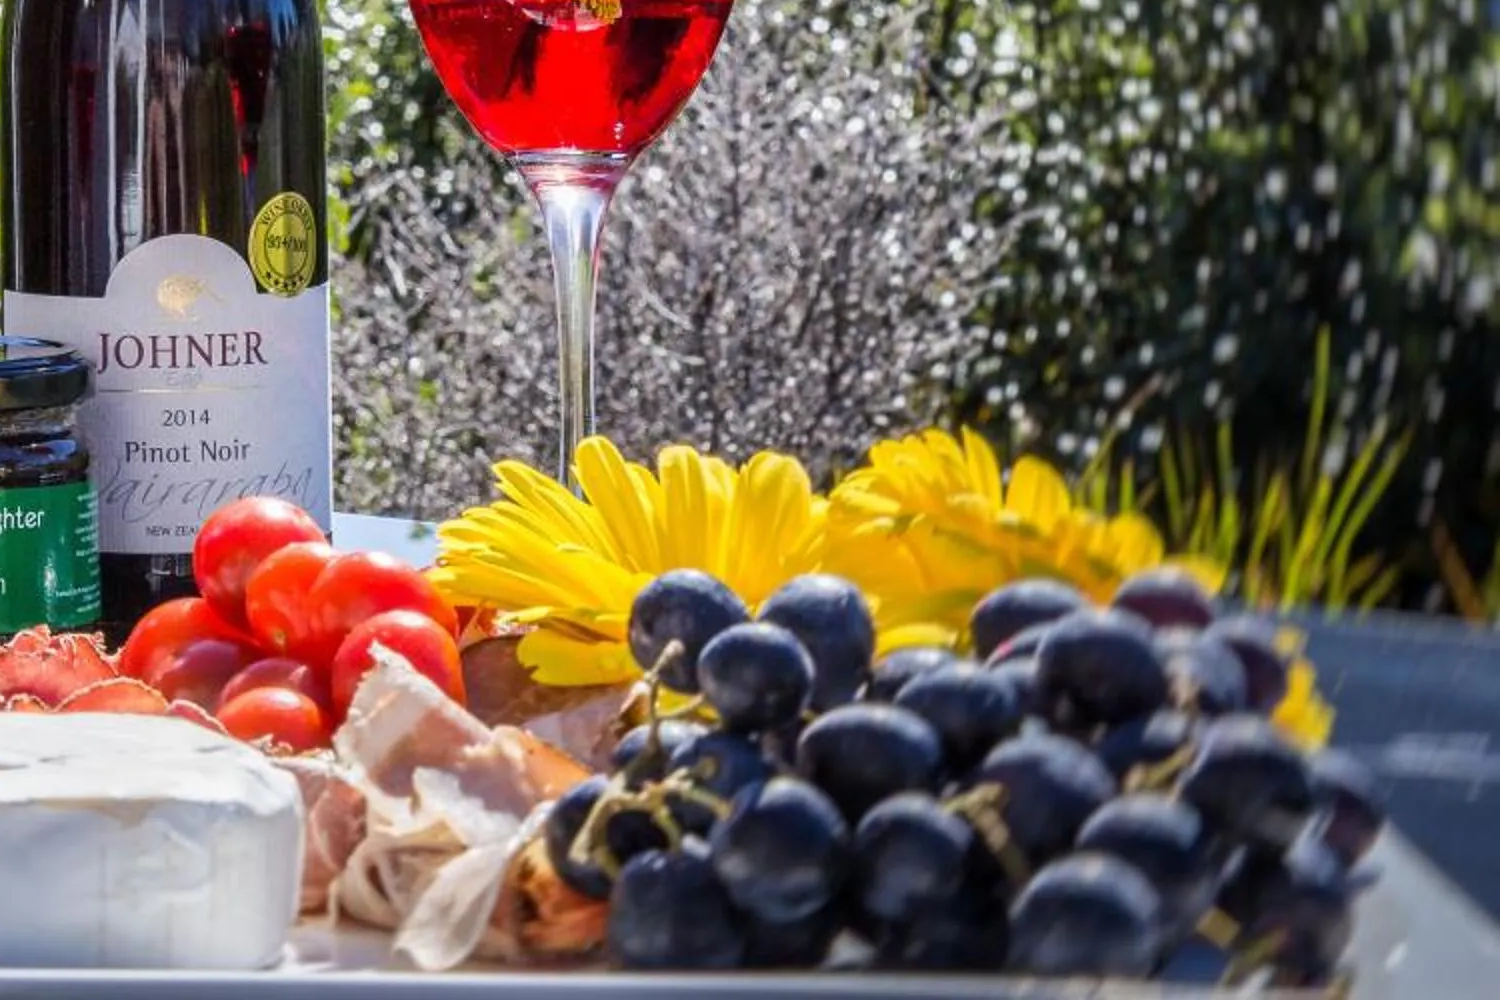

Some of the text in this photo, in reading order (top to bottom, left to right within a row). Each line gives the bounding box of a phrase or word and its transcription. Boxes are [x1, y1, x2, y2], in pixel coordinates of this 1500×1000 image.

[98, 331, 268, 375] JOHNER
[163, 409, 211, 427] 2014
[125, 439, 252, 463] Pinot Noir
